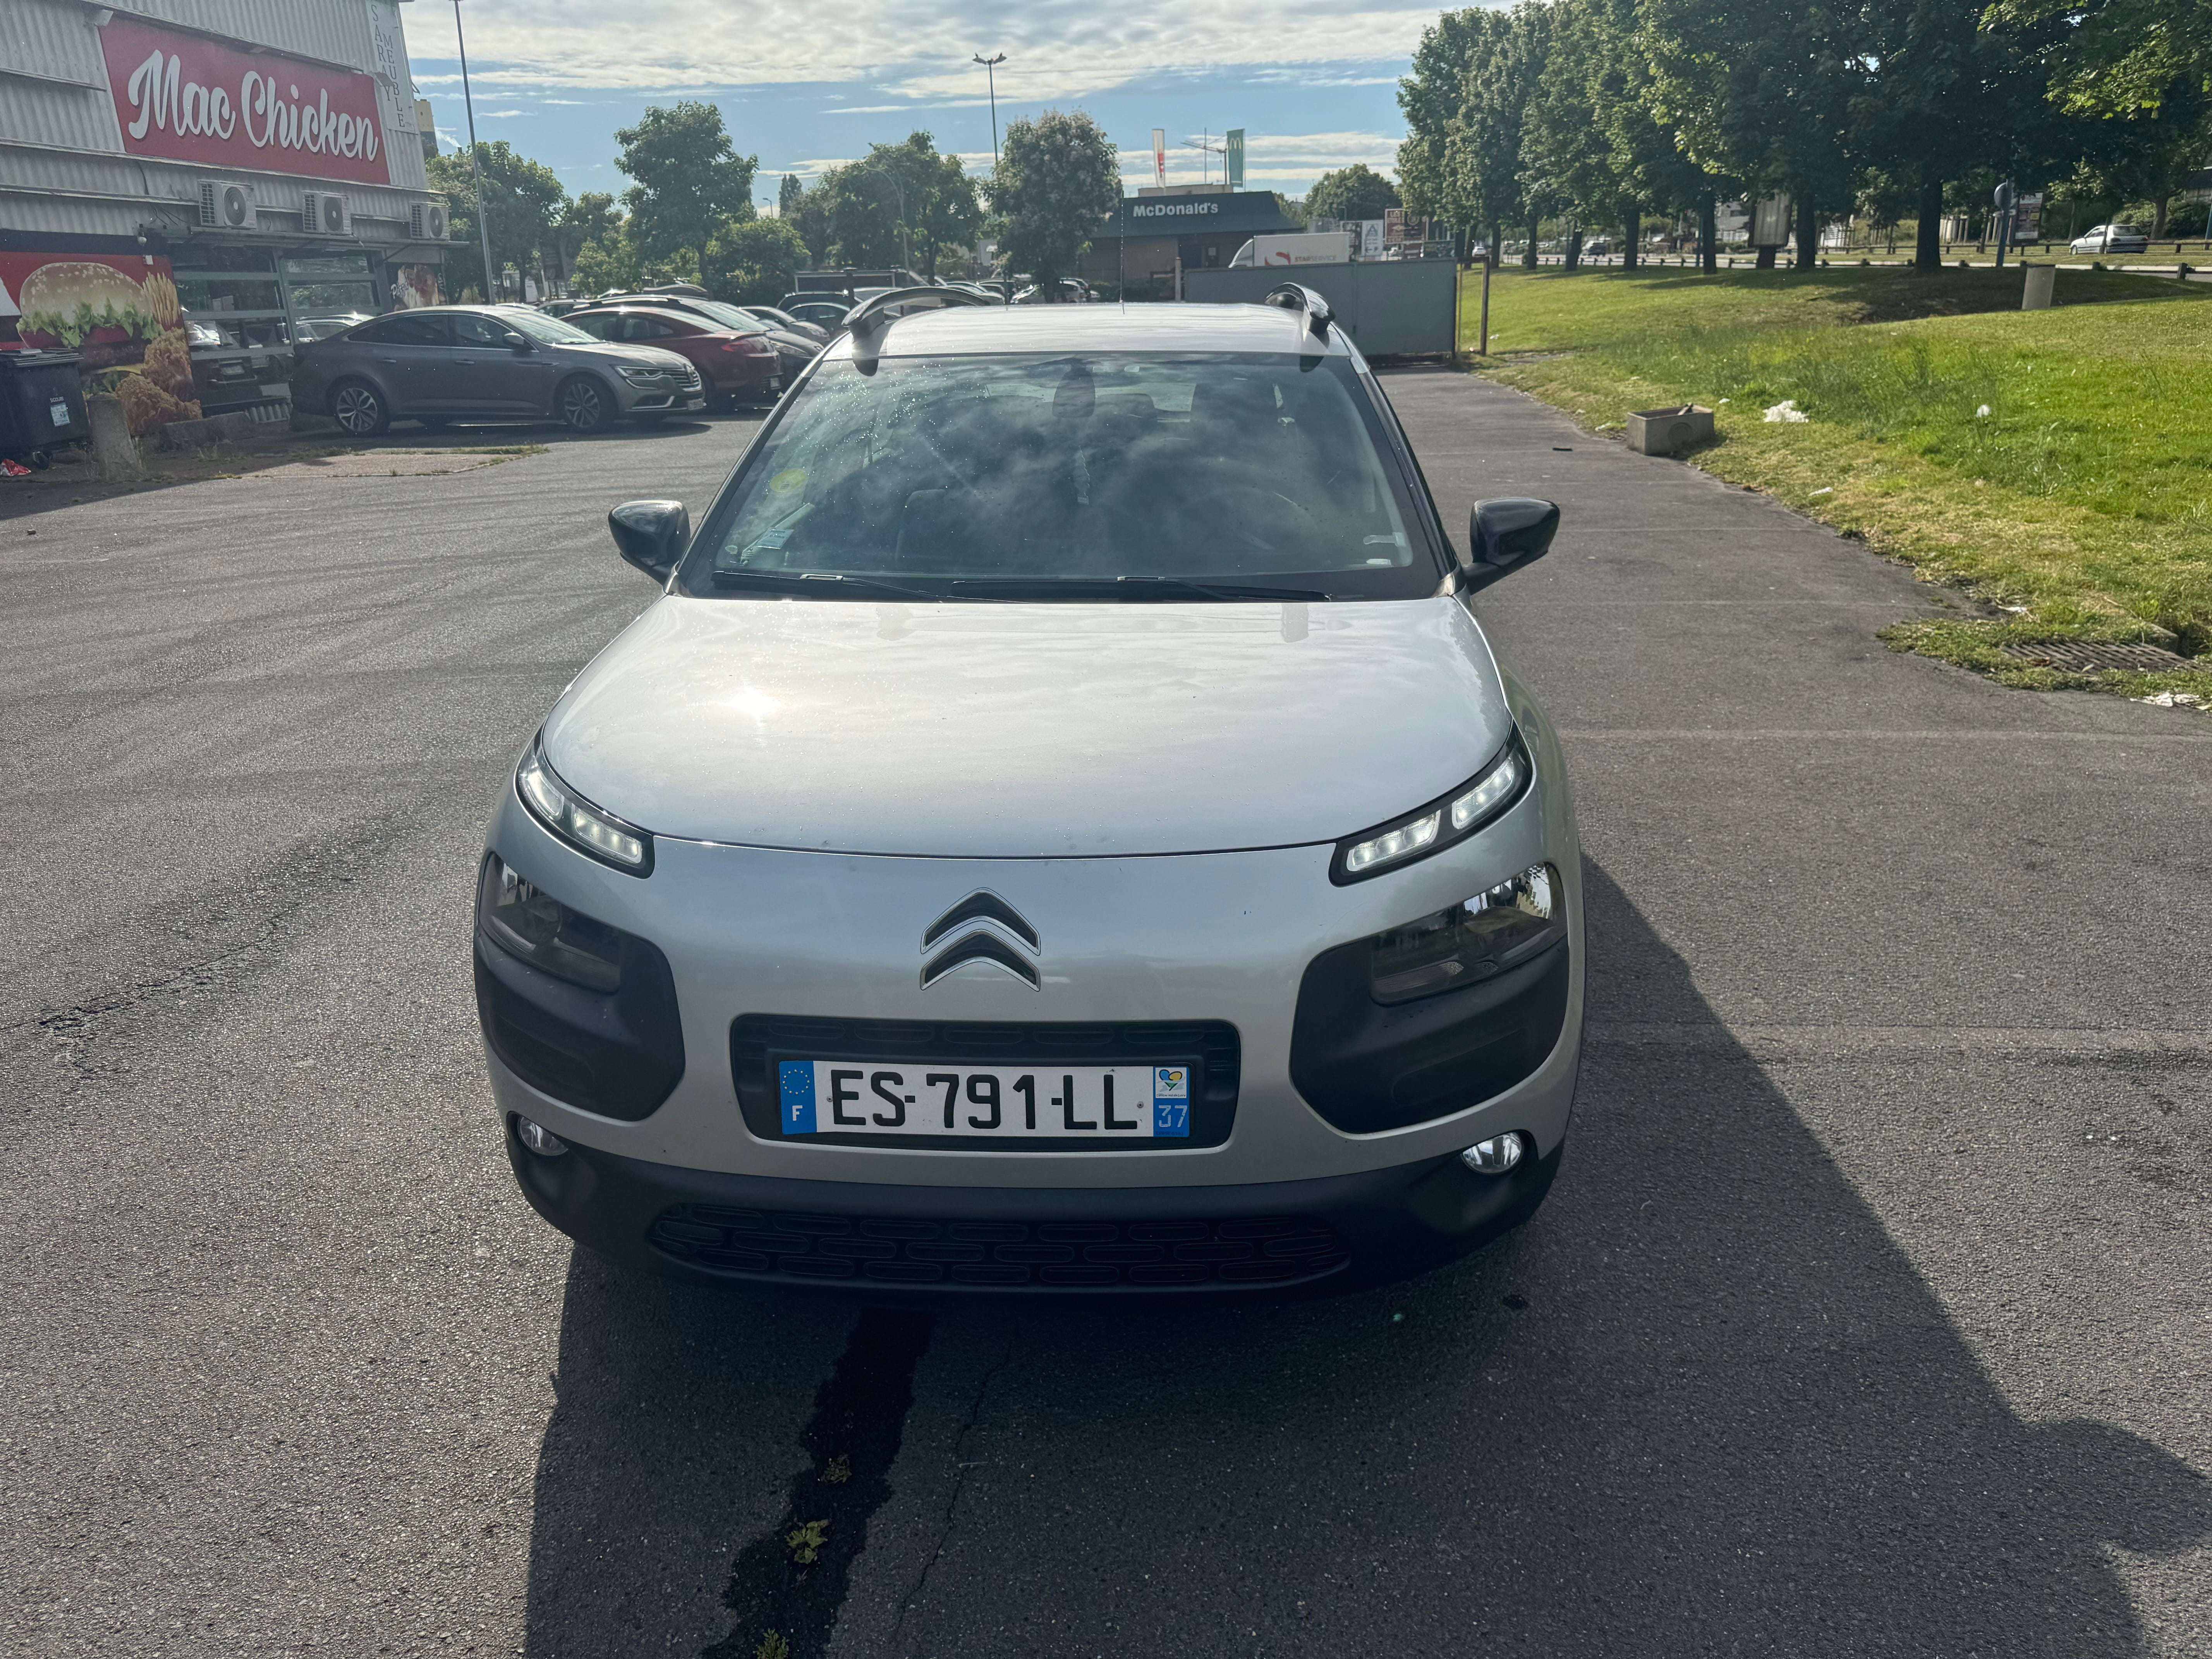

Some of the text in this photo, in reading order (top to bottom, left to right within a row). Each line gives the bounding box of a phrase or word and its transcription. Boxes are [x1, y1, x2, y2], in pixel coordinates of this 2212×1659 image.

[383, 33, 405, 127] MEUBLE
[128, 50, 378, 161] Mac Chicken
[1133, 203, 1219, 217] McDonald's
[792, 1105, 803, 1121] F
[831, 1069, 1138, 1130] ES-791-LL
[1158, 1105, 1188, 1128] 37
